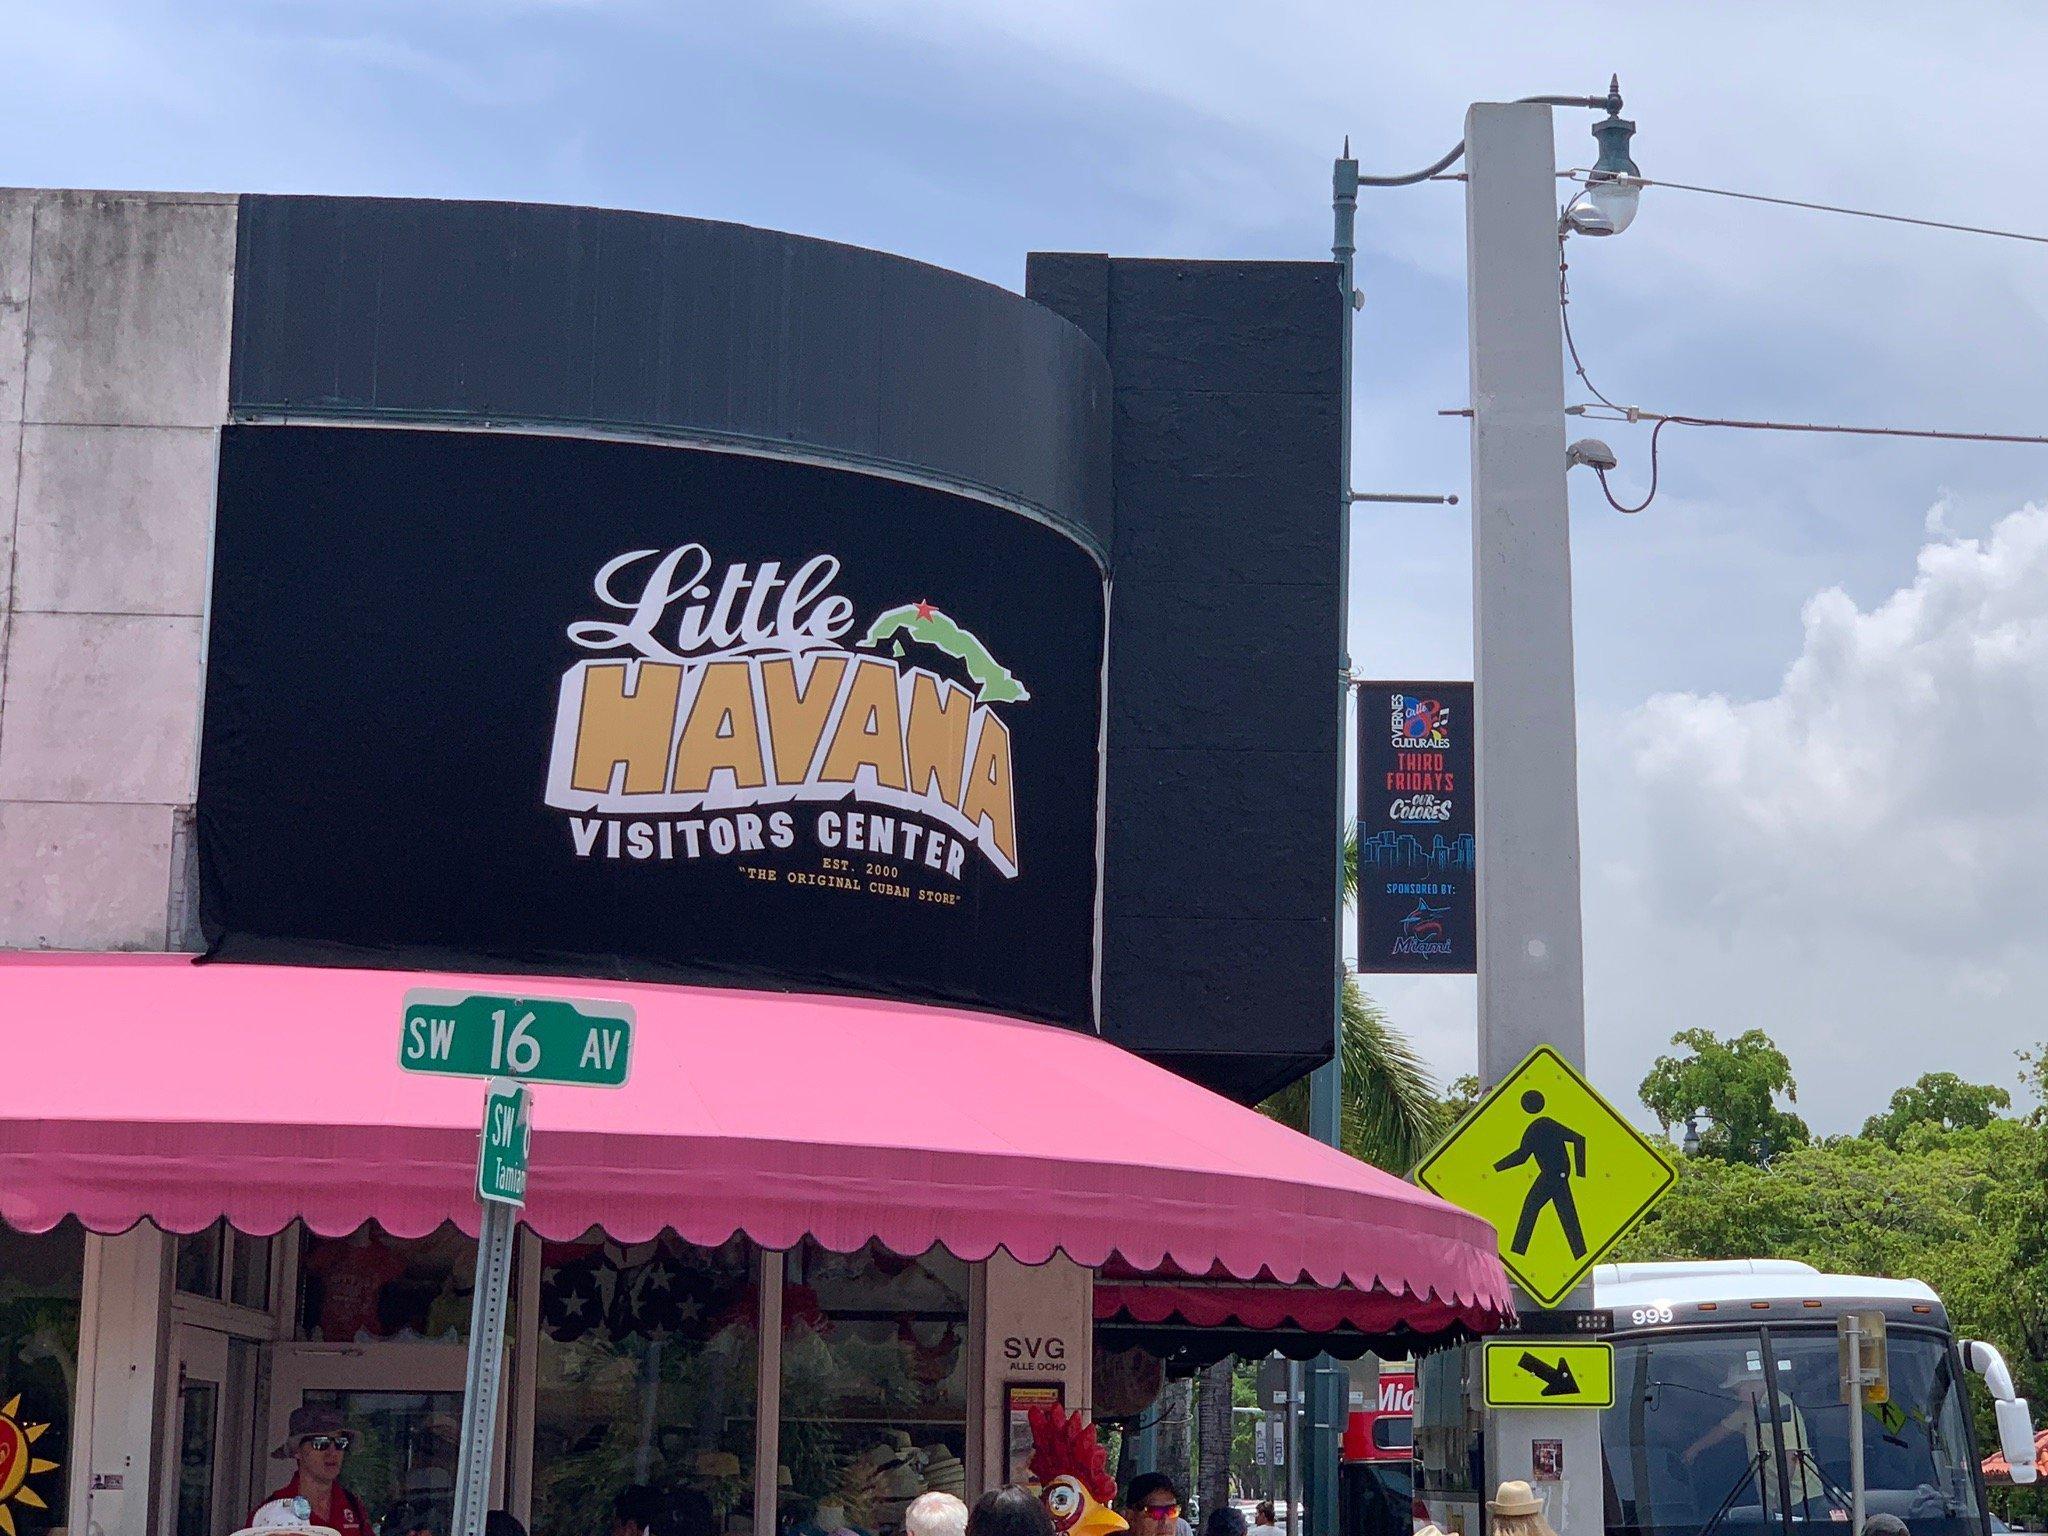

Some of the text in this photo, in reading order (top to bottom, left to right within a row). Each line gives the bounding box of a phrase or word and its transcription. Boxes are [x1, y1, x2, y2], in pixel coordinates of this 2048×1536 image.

[567, 543, 855, 659] Little
[1391, 694, 1404, 738] VIERNES
[1391, 738, 1450, 749] CULTURALES
[545, 652, 1018, 878] HAVANA
[1398, 753, 1443, 771] THIRD
[1387, 772, 1454, 791] FRIDAYS
[569, 811, 966, 881] VISITORS CENTER
[822, 857, 899, 878] EST. 2000
[787, 872, 861, 890] ORIGINAL
[869, 881, 910, 898] CUBAN
[1387, 884, 1456, 894] SPONSORED BY:
[407, 1009, 622, 1073] SW 16 AV
[492, 1103, 515, 1148] SW
[1632, 1309, 1674, 1325] 999
[1004, 1336, 1065, 1359] SVG
[1037, 1362, 1066, 1371] OCHO
